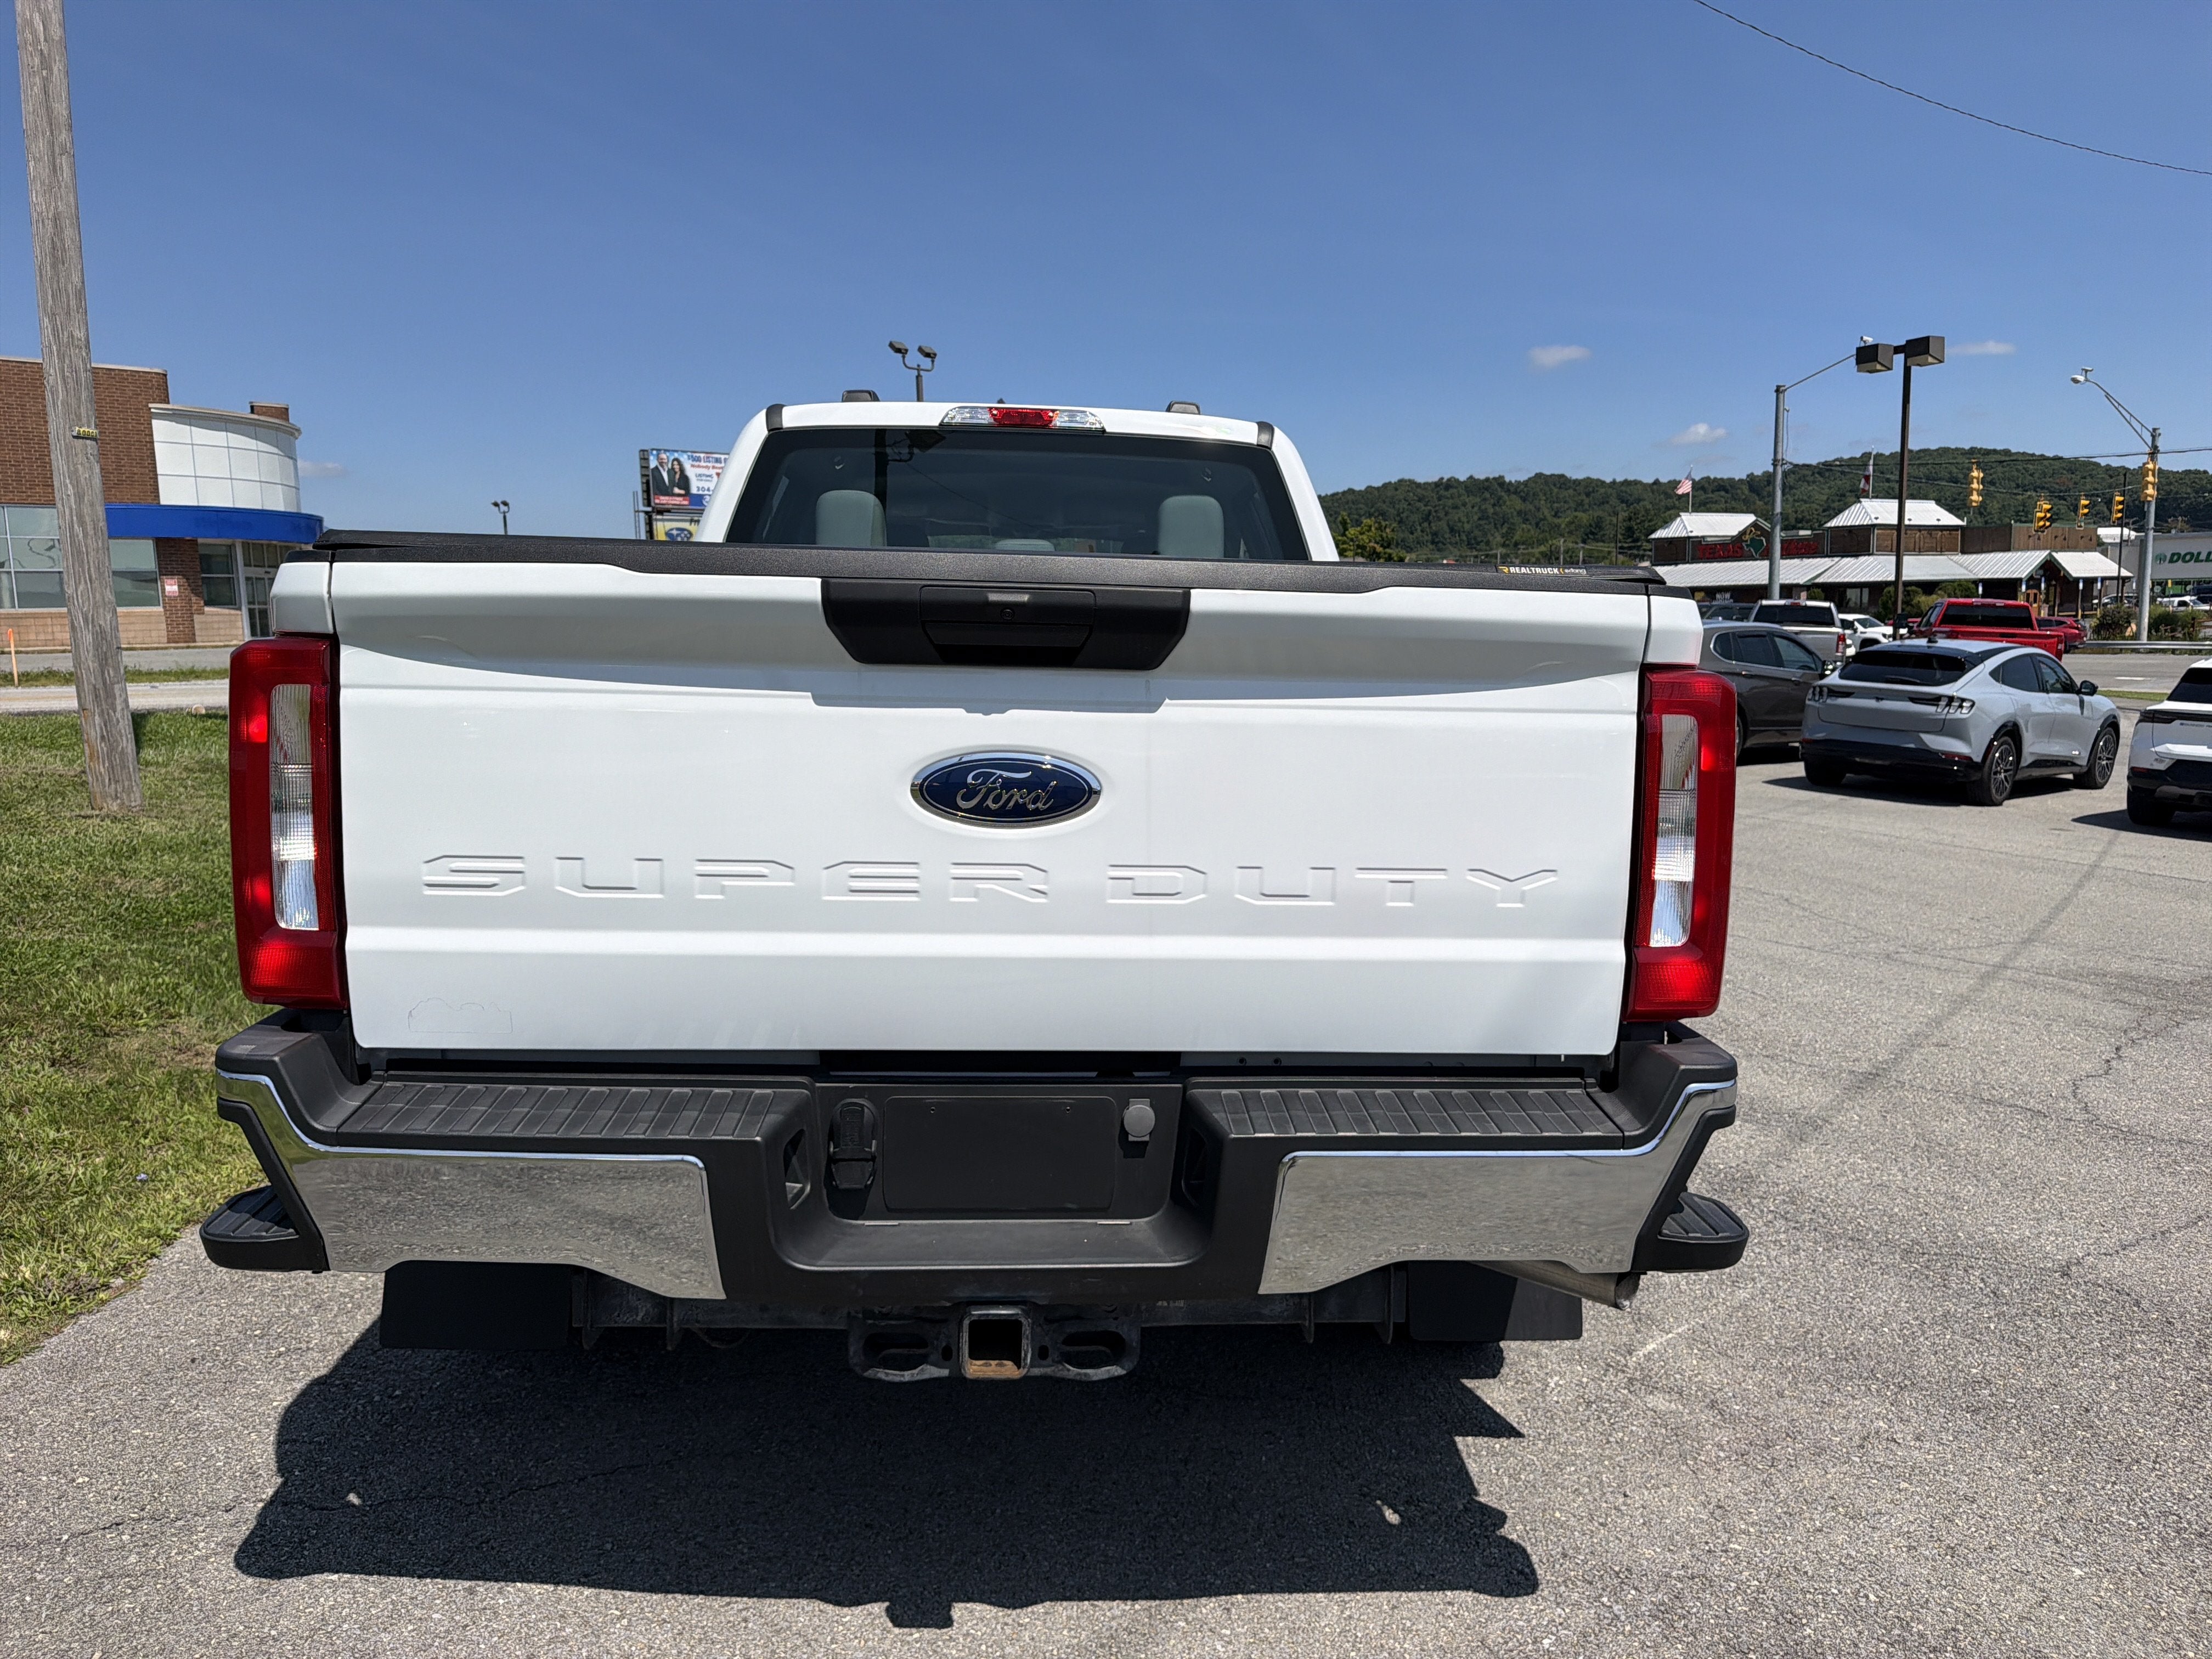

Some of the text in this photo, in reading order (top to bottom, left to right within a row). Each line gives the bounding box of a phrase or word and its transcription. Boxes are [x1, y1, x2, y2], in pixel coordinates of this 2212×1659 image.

[702, 455, 723, 464] LISTING
[1698, 543, 1743, 559] TEXAS
[1509, 566, 1560, 574] REALTRUCK
[956, 768, 1059, 811] Ford
[422, 855, 1558, 908] SUPER DUTY
